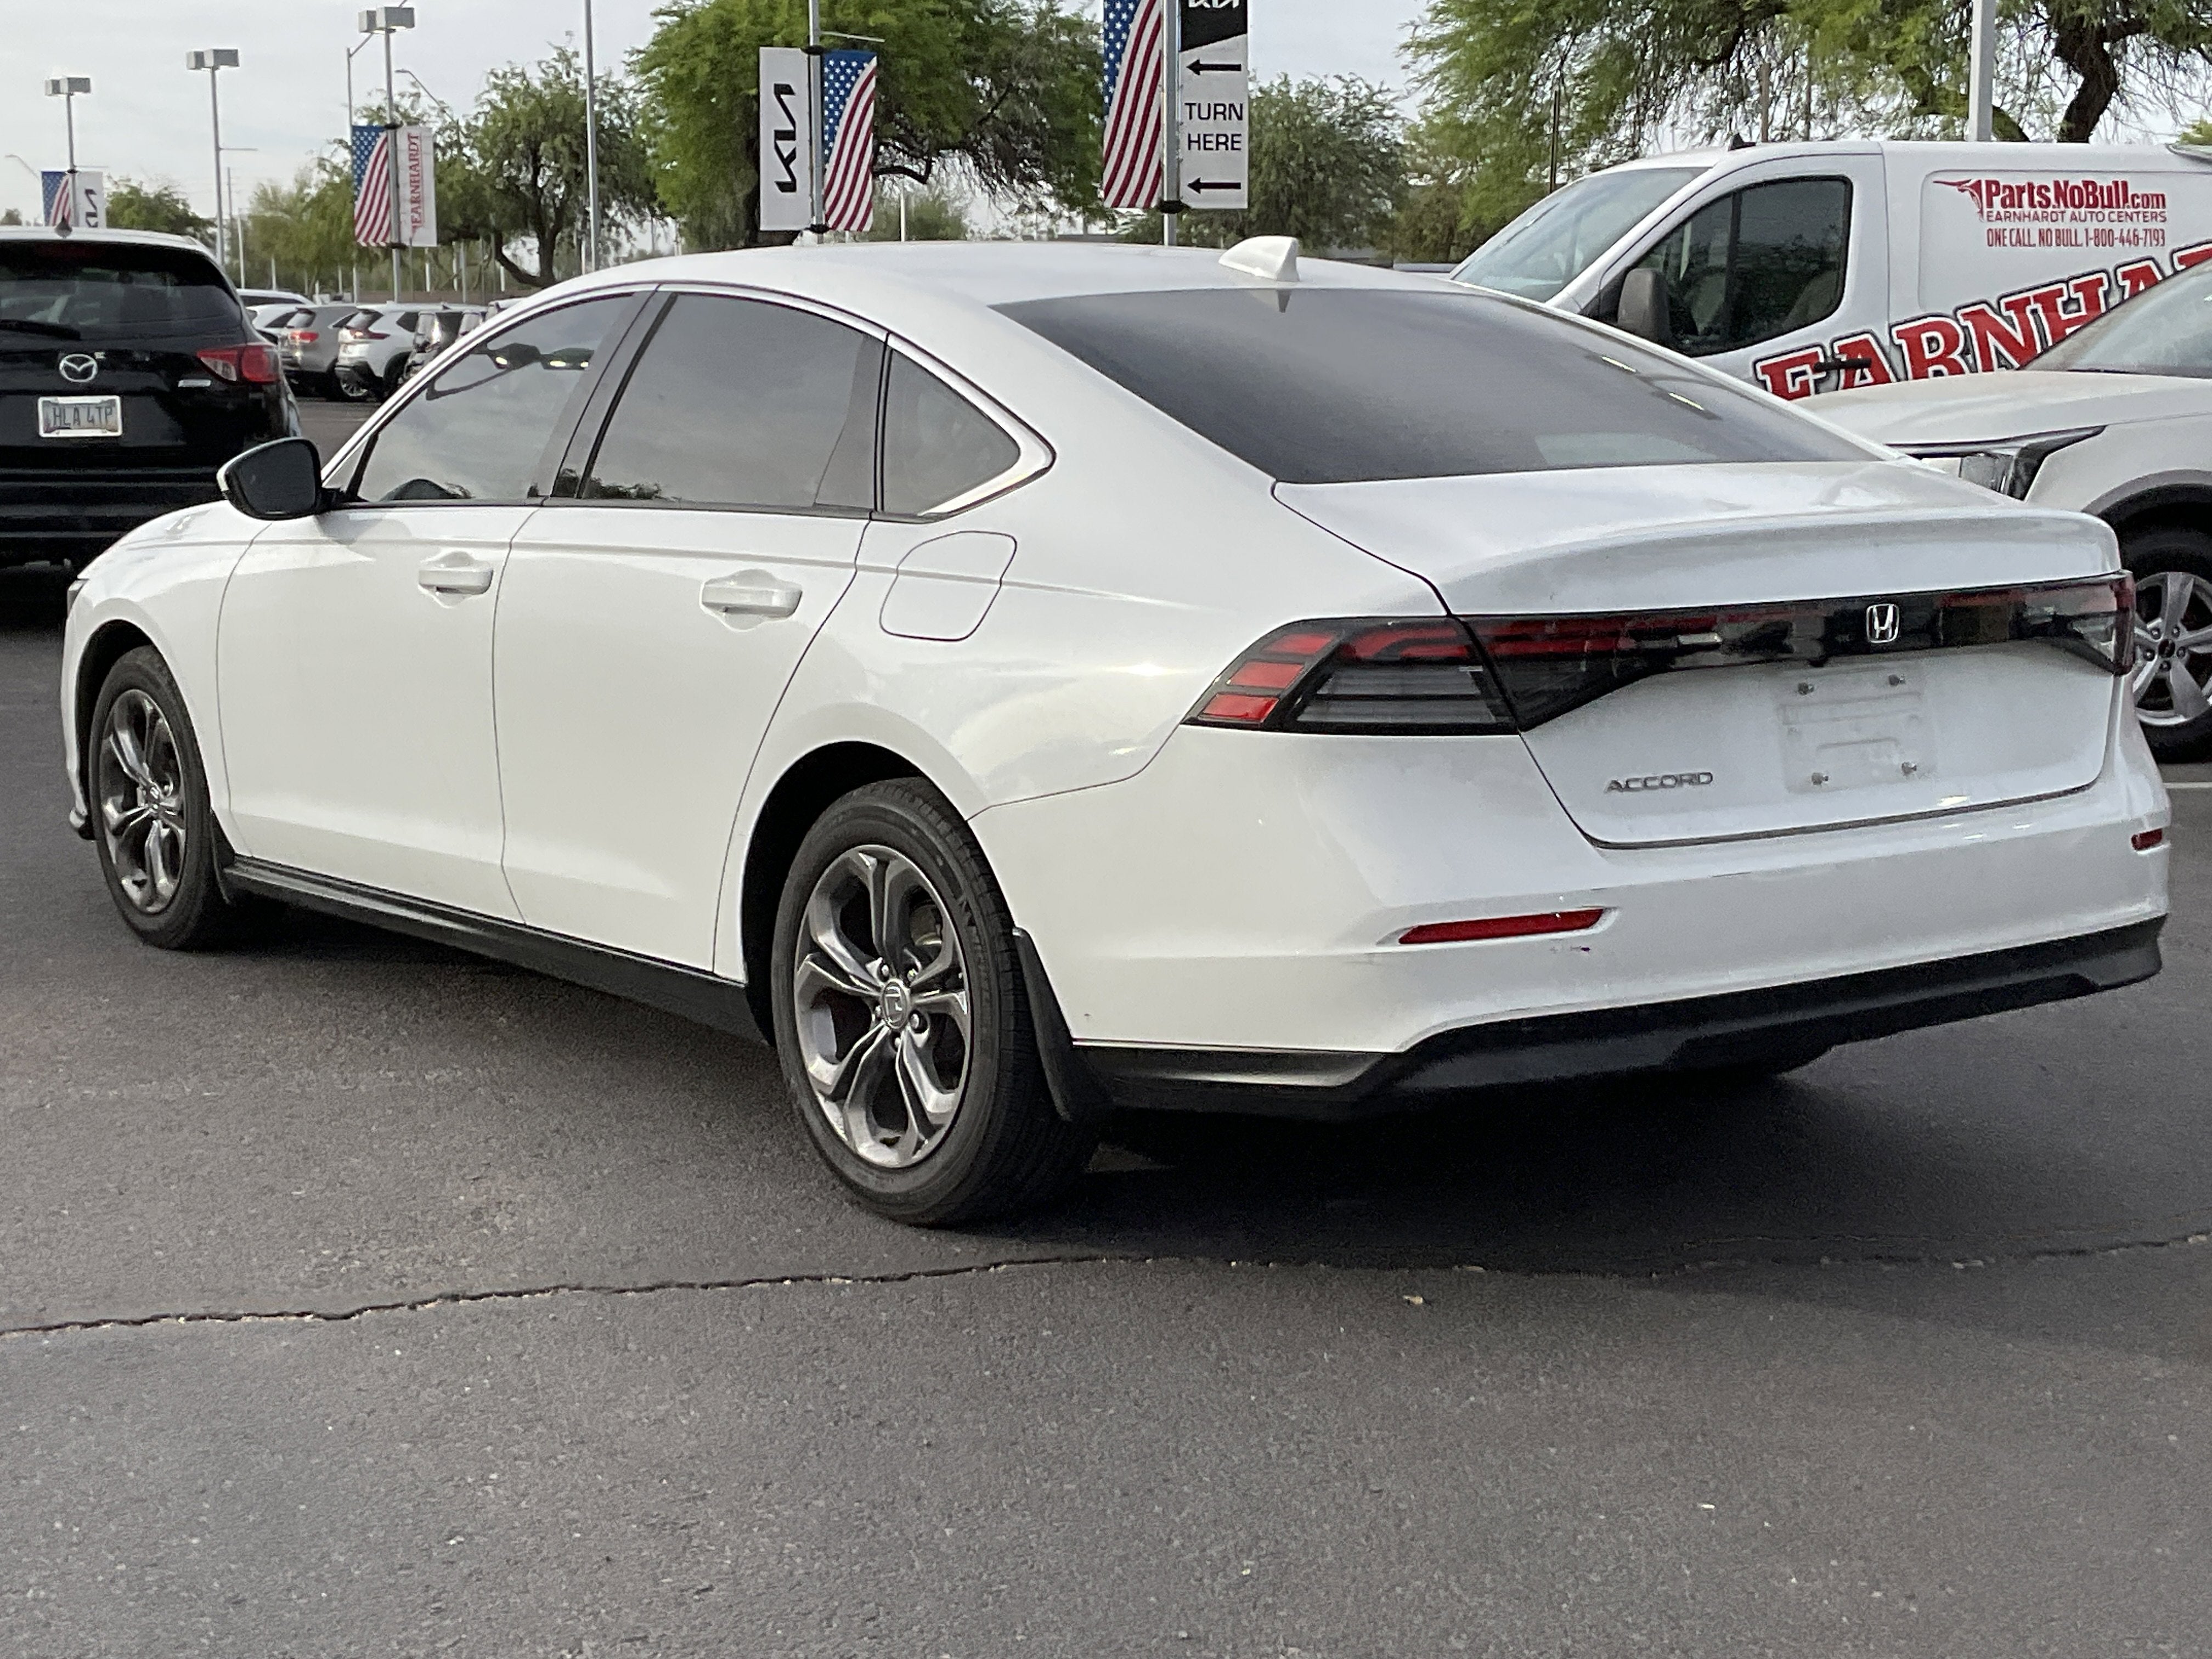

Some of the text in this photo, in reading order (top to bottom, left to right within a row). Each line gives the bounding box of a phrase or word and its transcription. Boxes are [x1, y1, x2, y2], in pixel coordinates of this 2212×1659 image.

[1184, 103, 1243, 121] TURN
[774, 83, 797, 193] KIA
[1188, 133, 1242, 151] HERE
[408, 132, 422, 225] EARNHARDT
[1987, 211, 2167, 223] EARNHARDT AUTO CENTERS
[1987, 228, 2165, 247] ONE CALL. NO BULL. 1-800-446-7193
[1754, 245, 2212, 402] EARNHA
[53, 406, 81, 426] HLA
[1604, 771, 1713, 793] ACCORD
